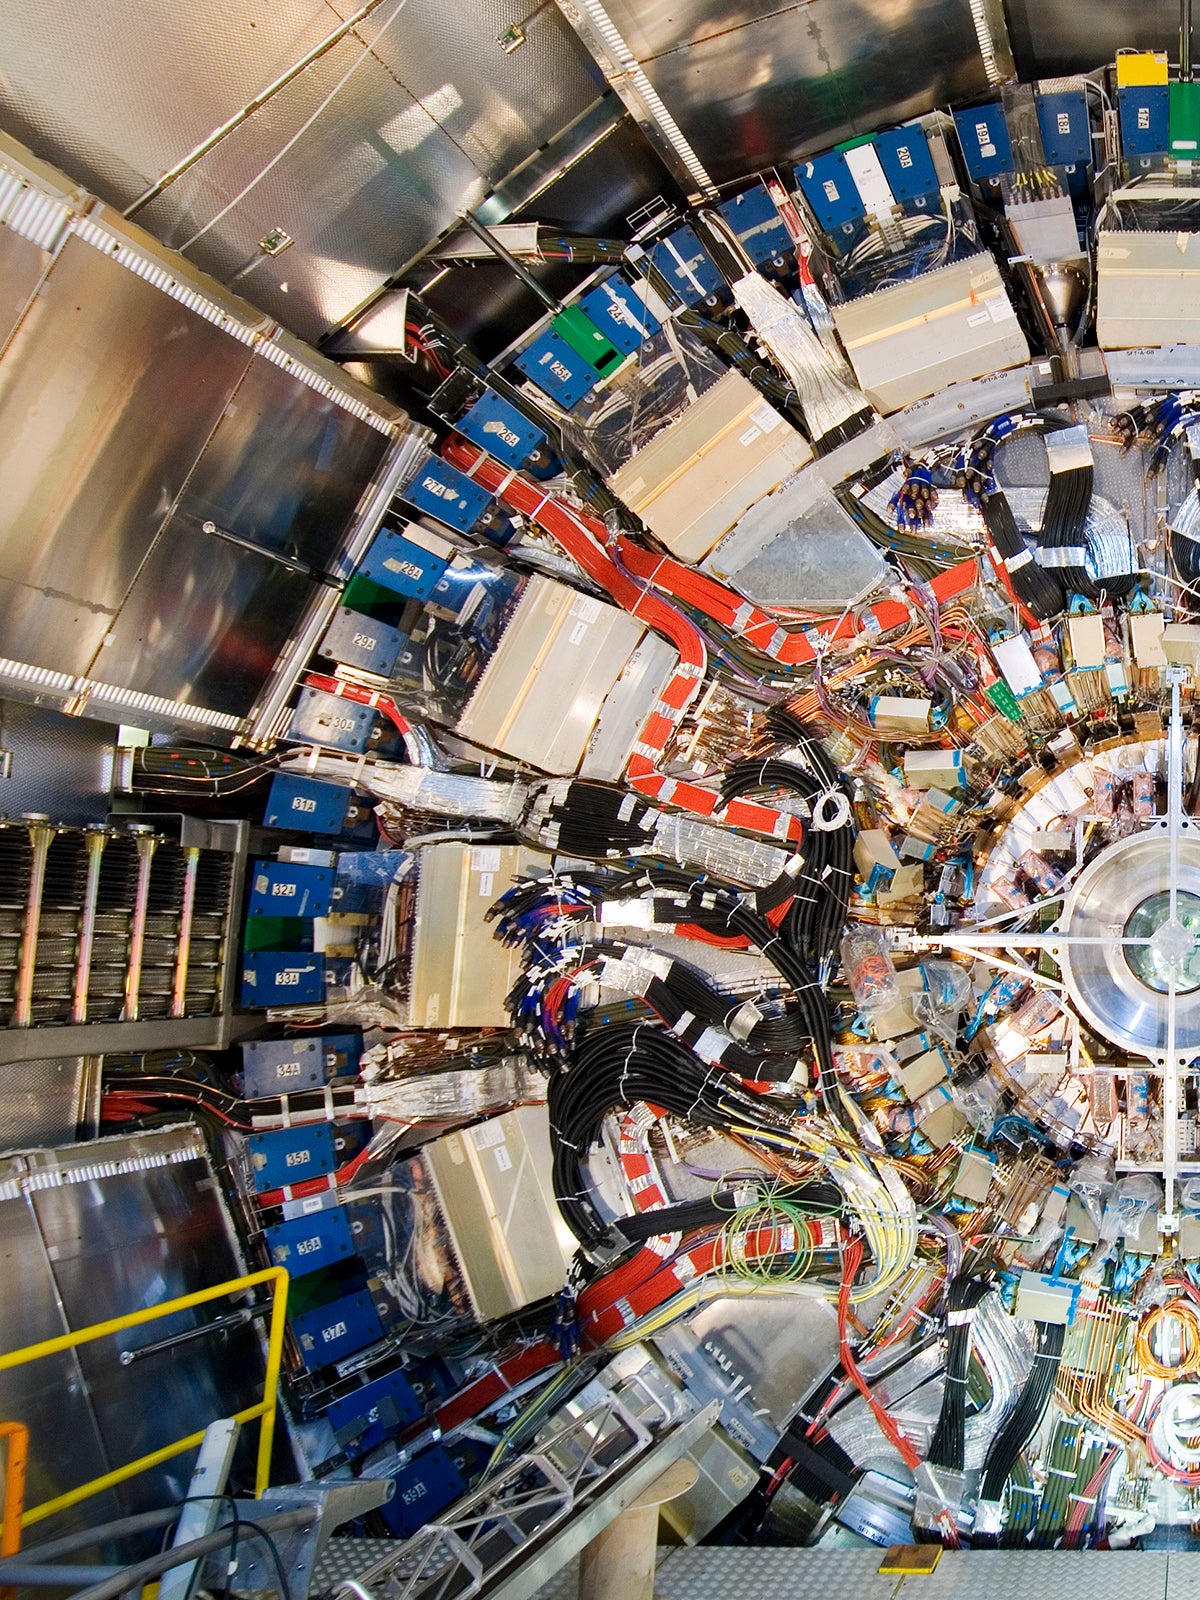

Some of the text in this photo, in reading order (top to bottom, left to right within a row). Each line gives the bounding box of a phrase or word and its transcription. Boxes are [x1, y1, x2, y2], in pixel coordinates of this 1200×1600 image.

[1059, 114, 1070, 134] 18A
[1138, 109, 1149, 128] 17A
[977, 123, 990, 144] 19A
[897, 147, 912, 168] 20A
[551, 362, 569, 381] 25A
[498, 428, 519, 446] 26A
[424, 478, 444, 496] 27A
[402, 562, 422, 580] 28A
[354, 633, 375, 650] 29A
[334, 716, 353, 730] 30A
[294, 798, 315, 812] 31A
[274, 884, 294, 896] 32A
[277, 973, 298, 985] 33A
[278, 1064, 299, 1076] 34A
[288, 1151, 309, 1166] 35A
[299, 1237, 320, 1255] 36A
[323, 1322, 346, 1341] 37A
[403, 1483, 426, 1504] 39A
